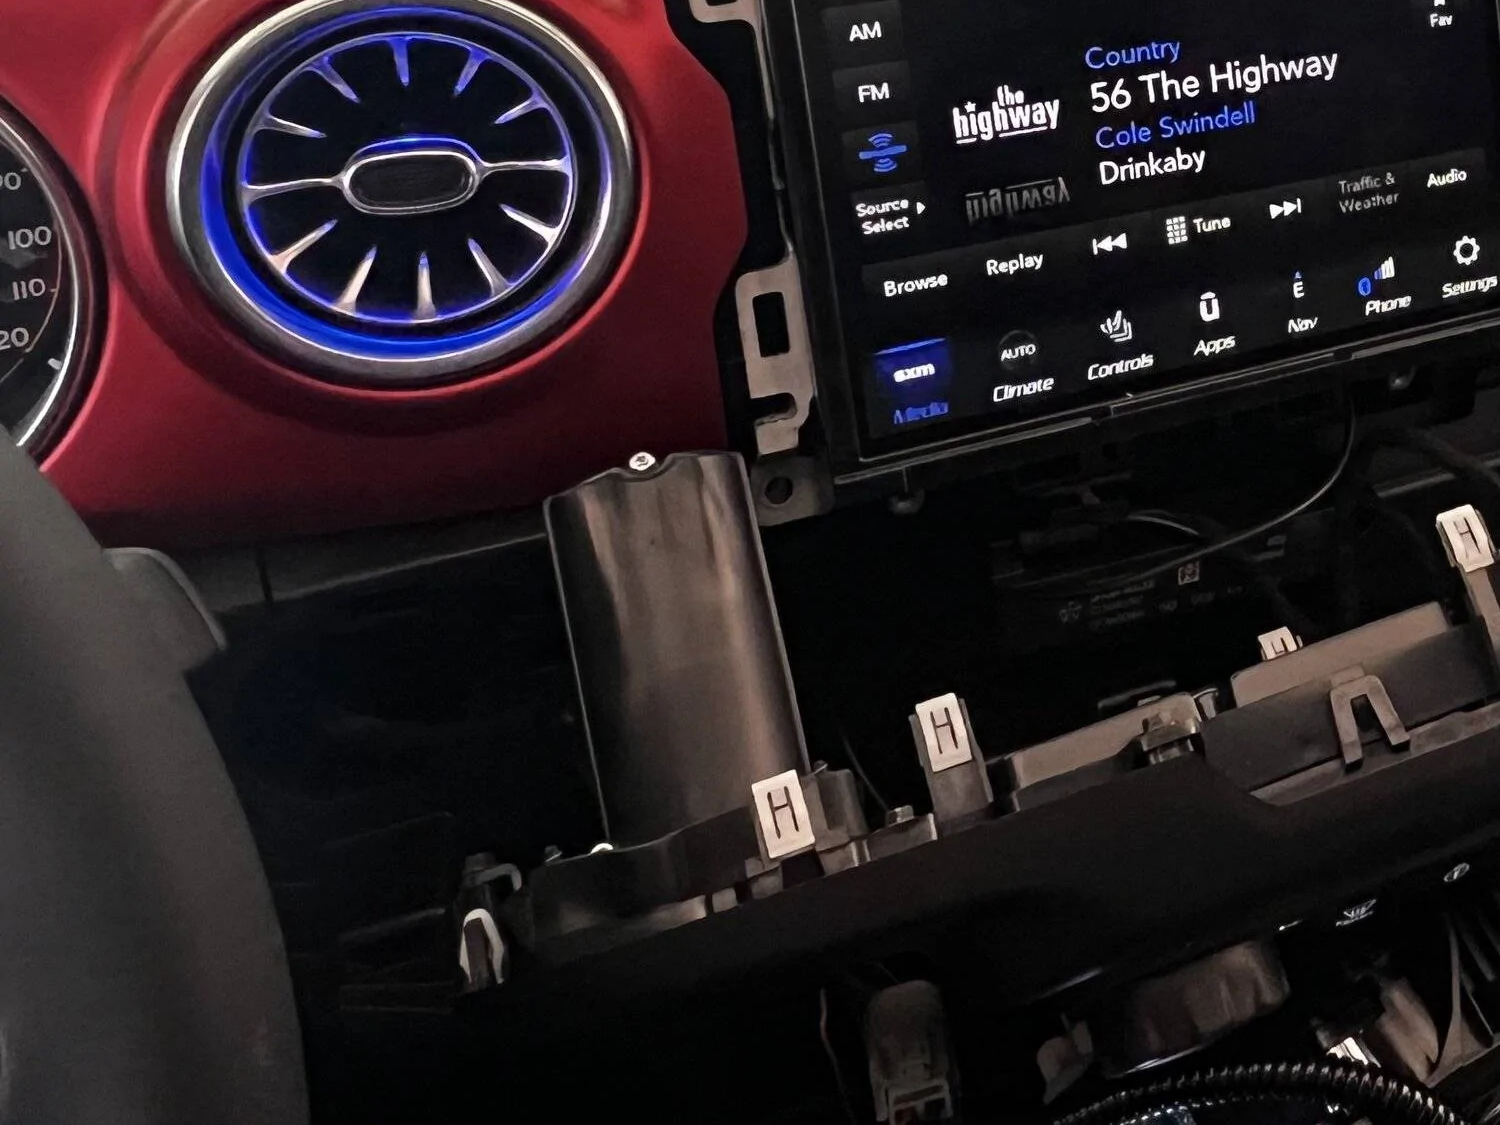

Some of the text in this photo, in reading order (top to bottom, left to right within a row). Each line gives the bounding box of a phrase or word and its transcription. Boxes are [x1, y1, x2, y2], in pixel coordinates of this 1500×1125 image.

[1430, 13, 1452, 27] Fav
[850, 21, 881, 41] AM
[1084, 41, 1180, 69] Country
[858, 83, 889, 102] FM
[1091, 54, 1337, 112] 56 The Highway
[996, 85, 1024, 106] the
[952, 98, 1060, 141] highway
[1096, 100, 1256, 148] Cole Swindell
[1099, 147, 1206, 185] Drinkaby
[0, 172, 22, 190] 0
[1338, 172, 1395, 194] Traffic &
[1427, 169, 1467, 187] Audio
[856, 199, 909, 217] Source
[1338, 191, 1399, 213] Weather
[861, 216, 910, 235] Select
[1193, 218, 1230, 233] Tune
[8, 226, 51, 250] 100
[987, 254, 1043, 275] Replay
[13, 279, 45, 300] 110
[884, 274, 947, 296] Browse
[1442, 276, 1497, 298] Settings
[1365, 294, 1412, 316] Phone
[1288, 317, 1318, 333] Nav
[1001, 344, 1036, 361] AUTO
[1194, 336, 1235, 356] Apps
[1088, 354, 1153, 380] Controls
[993, 378, 1054, 402] Climate
